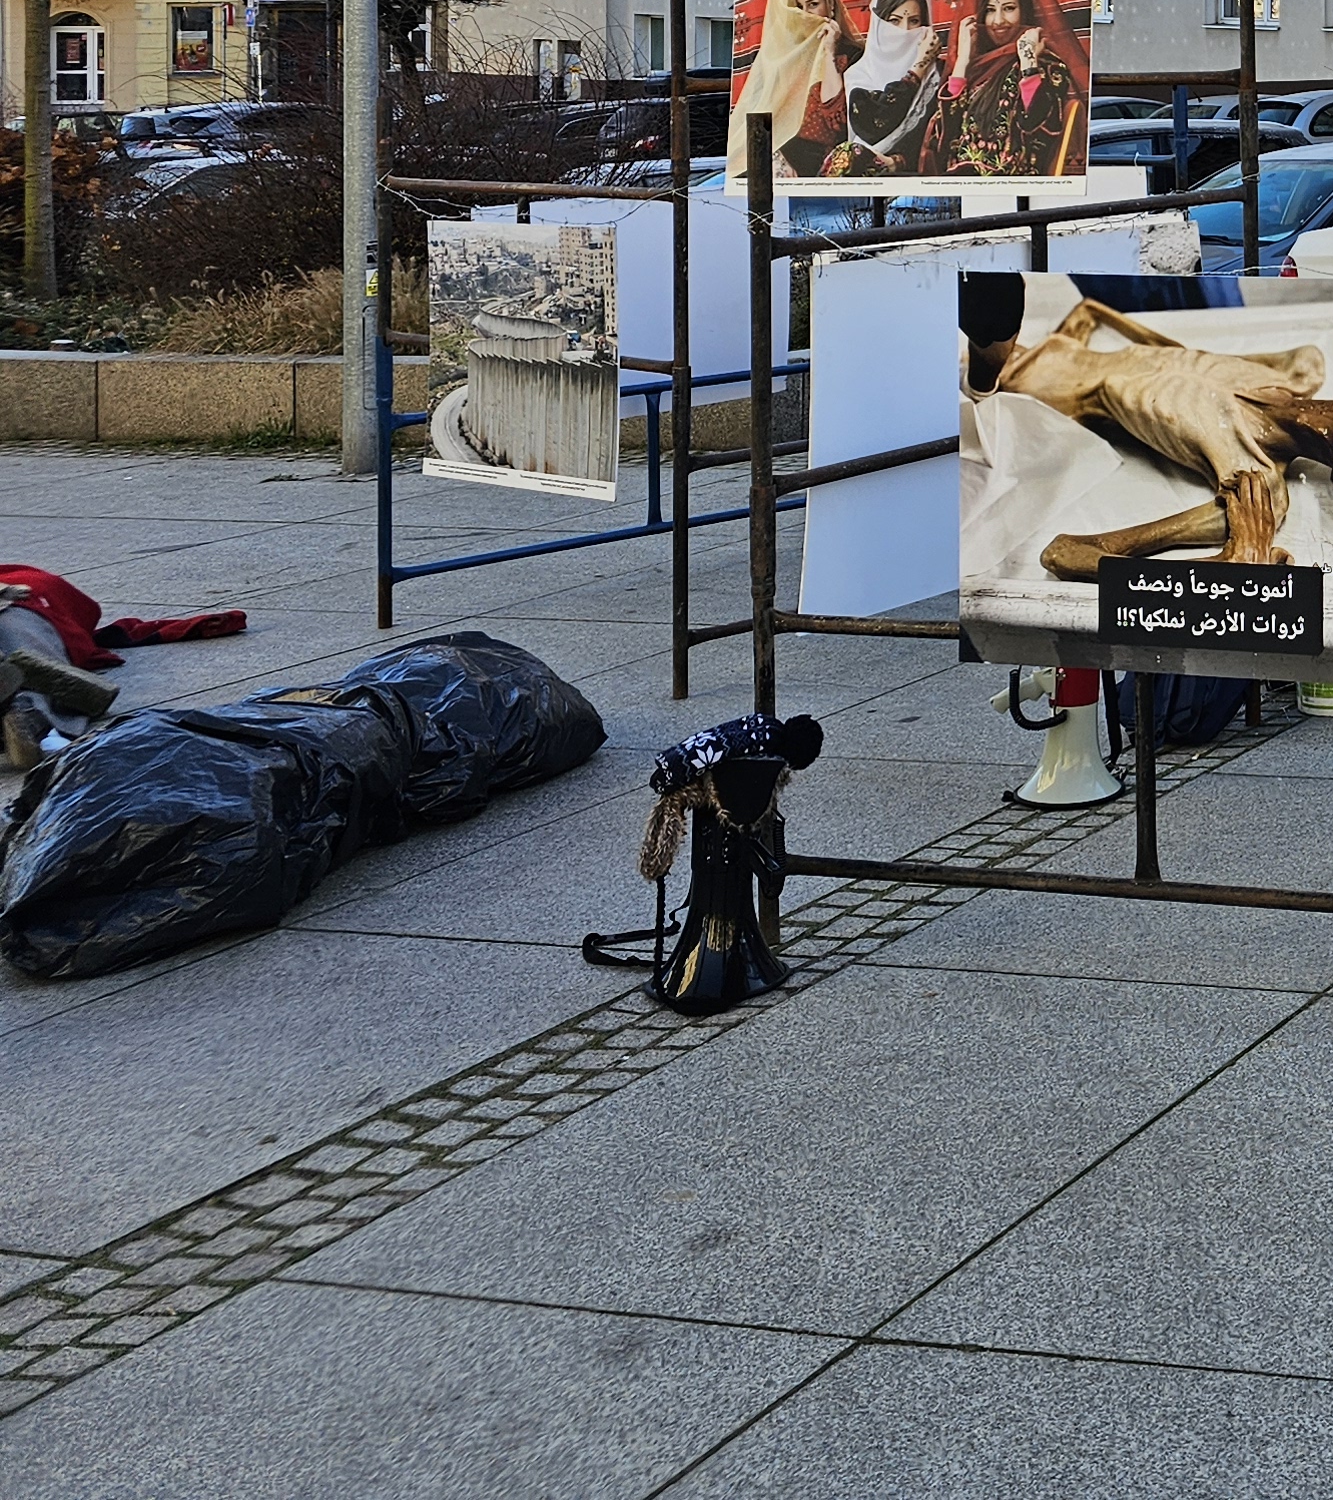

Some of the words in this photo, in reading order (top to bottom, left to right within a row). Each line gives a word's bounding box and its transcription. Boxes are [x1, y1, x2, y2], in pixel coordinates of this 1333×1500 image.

[1128, 573, 1184, 598] ونصف
[1189, 569, 1234, 601] جوعاً
[1241, 573, 1294, 602] أنموت
[1191, 608, 1245, 637] الأرض
[1251, 614, 1306, 640] ثروات
